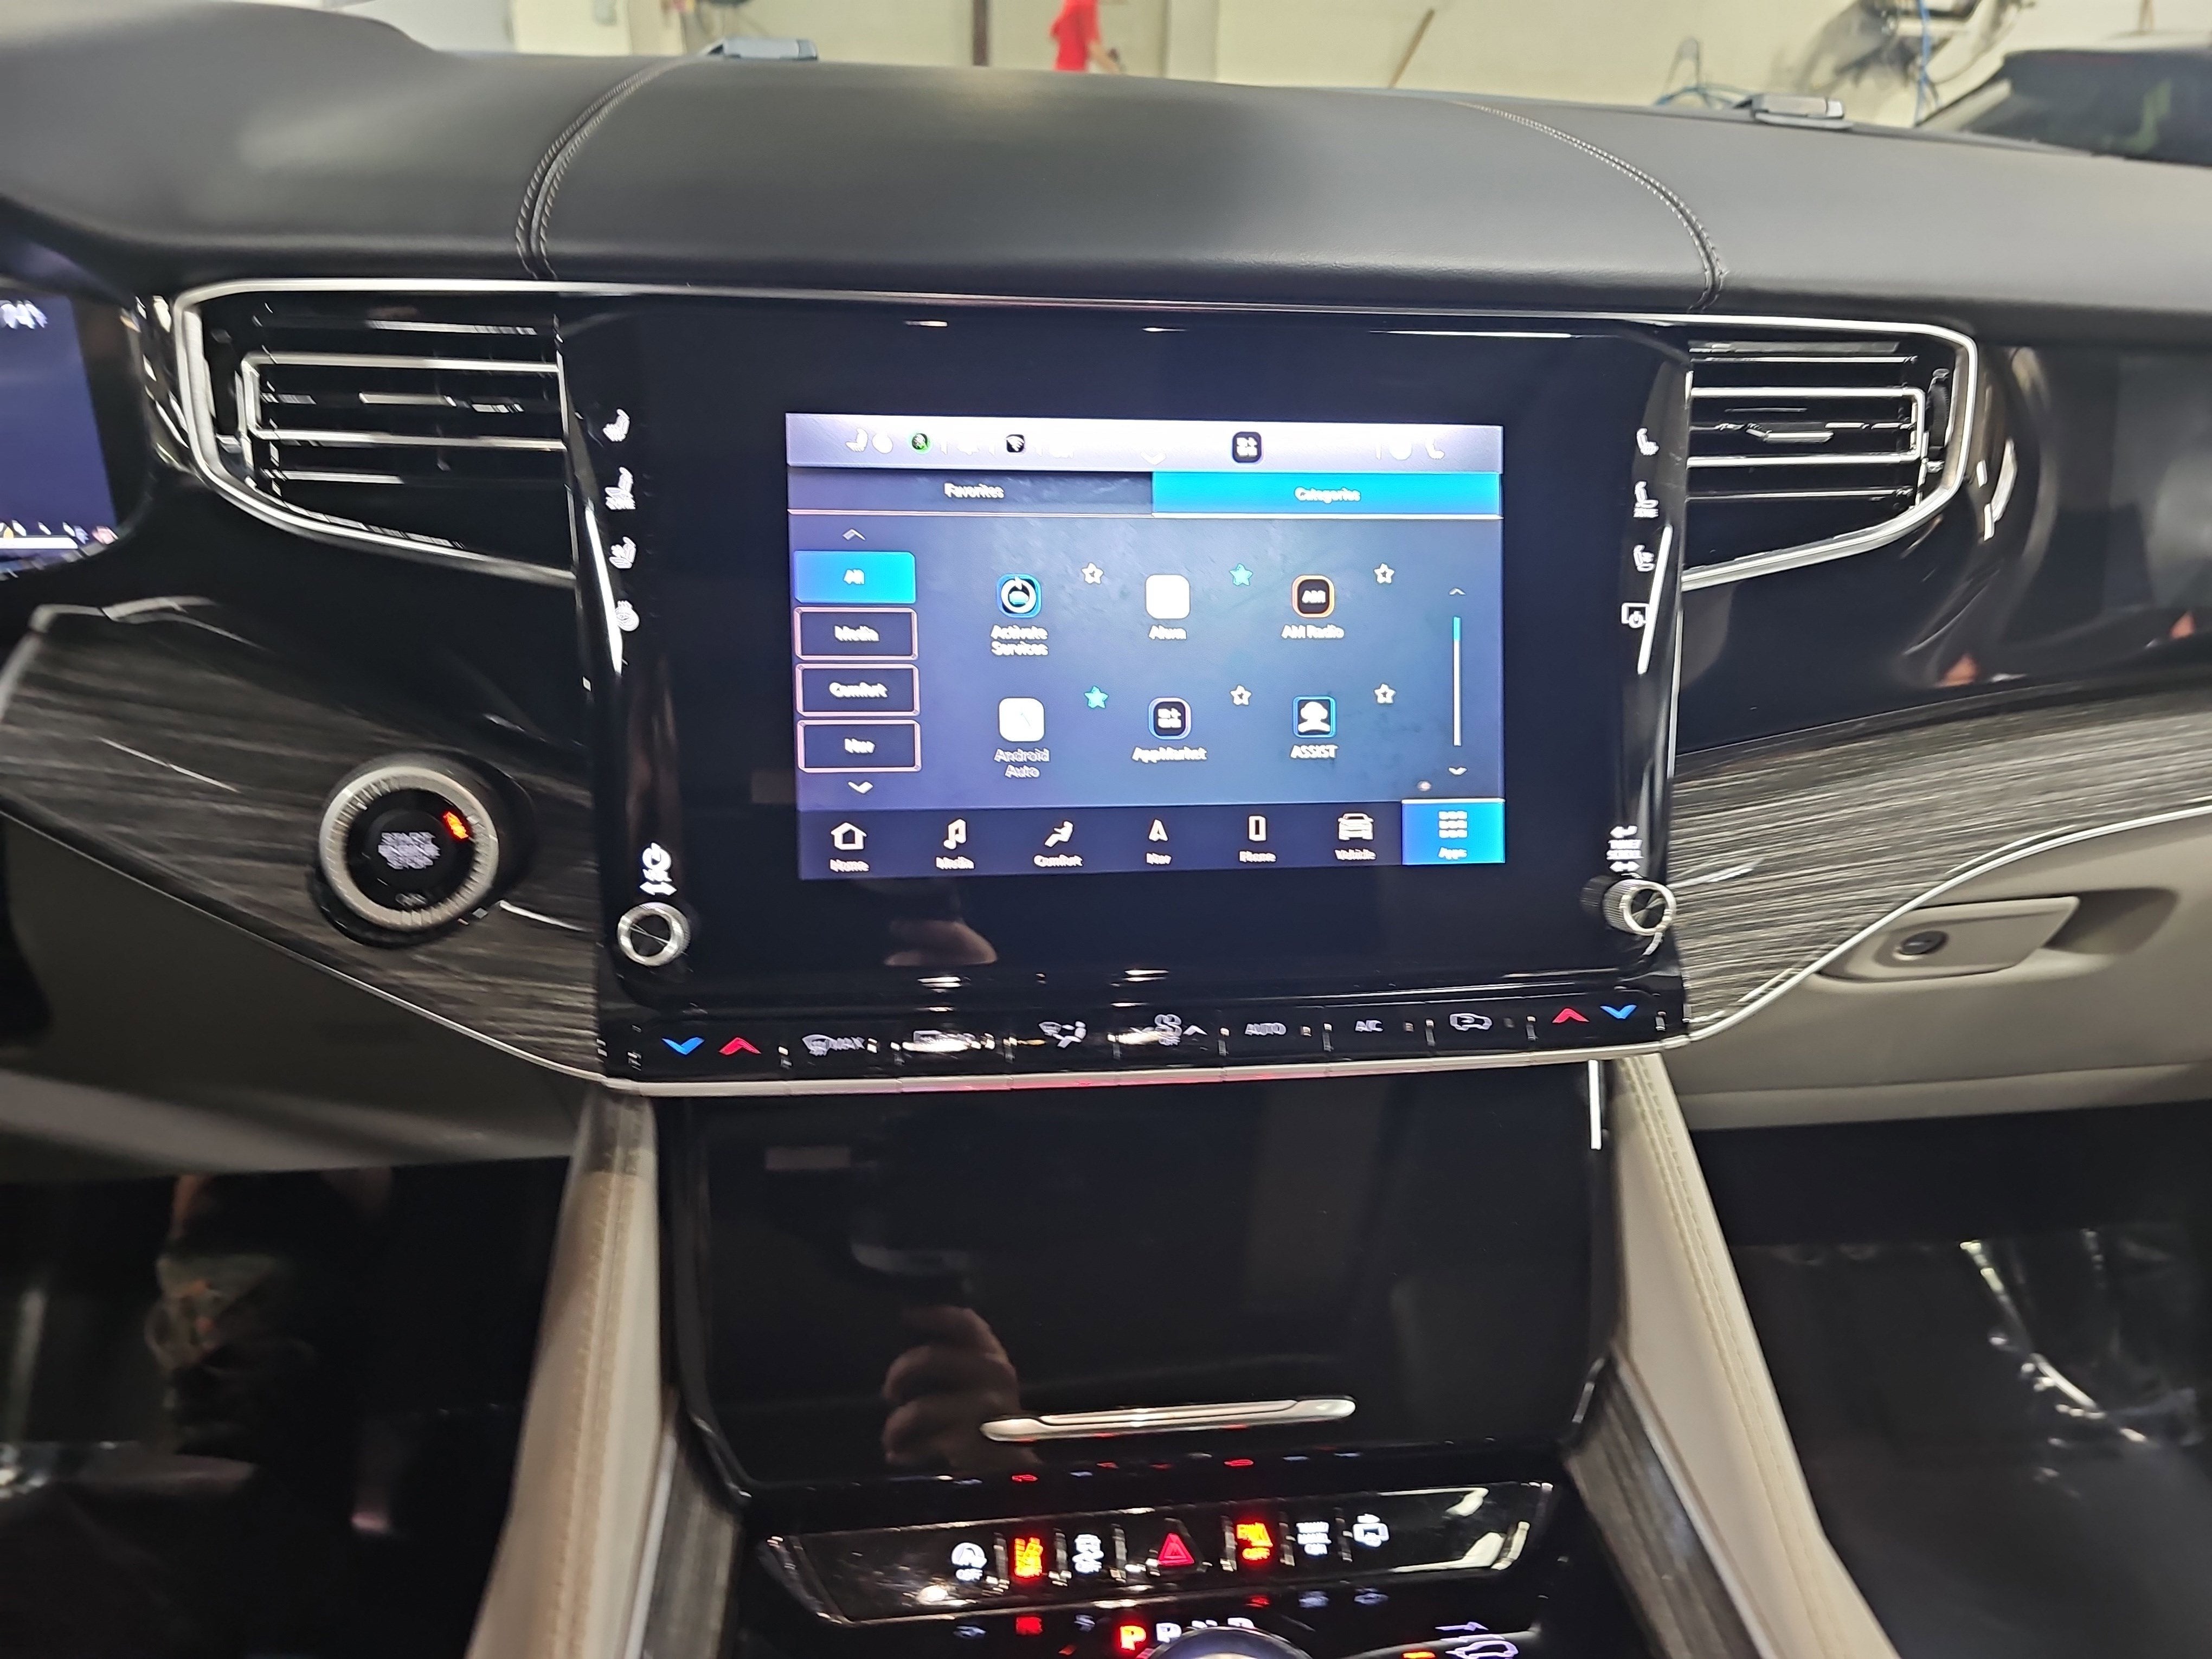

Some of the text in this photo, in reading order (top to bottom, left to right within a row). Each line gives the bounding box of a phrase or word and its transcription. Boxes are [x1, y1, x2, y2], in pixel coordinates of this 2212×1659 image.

[944, 483, 1004, 498] Favorites
[994, 748, 1050, 762] Android
[1290, 744, 1338, 758] ASSIST
[1005, 764, 1040, 778] Auto
[1120, 1625, 1147, 1651] P
